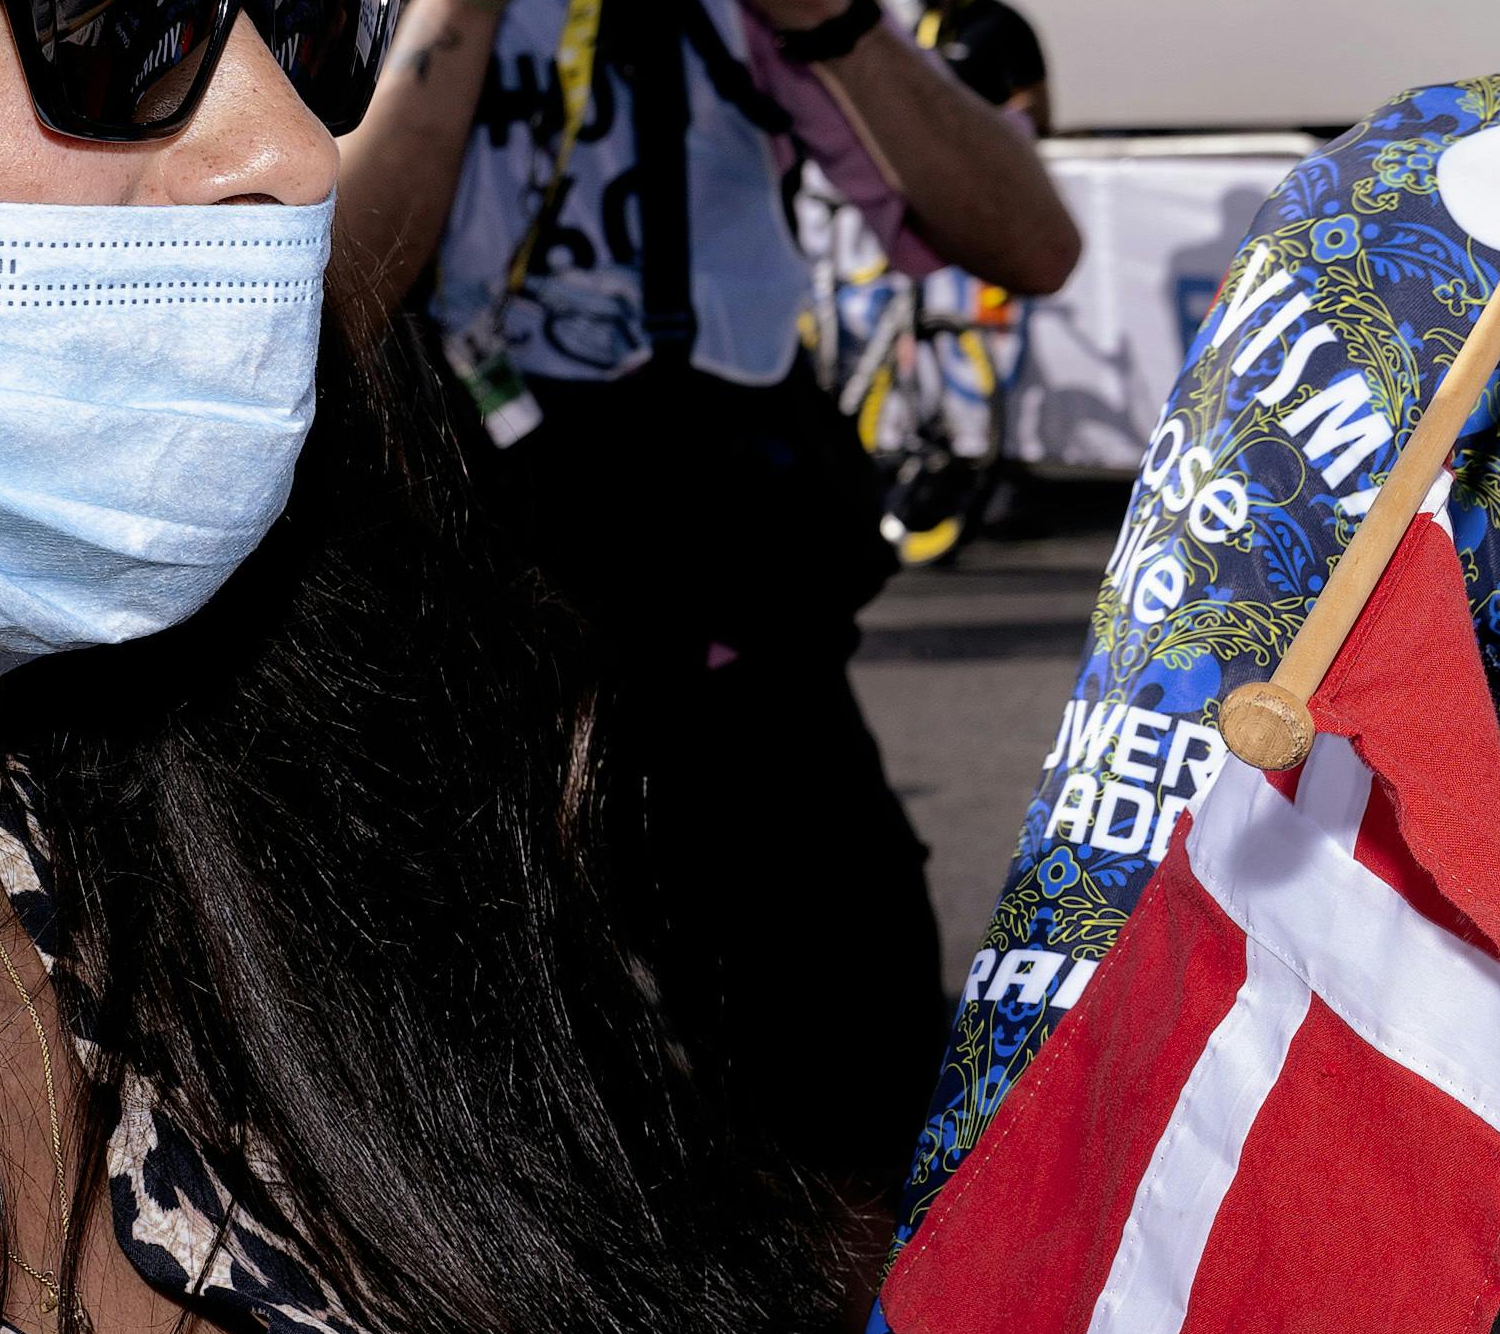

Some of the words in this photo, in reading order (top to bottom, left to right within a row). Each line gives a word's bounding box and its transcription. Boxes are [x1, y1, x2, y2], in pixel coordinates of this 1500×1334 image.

[1211, 243, 1394, 516] VISM
[1142, 402, 1249, 543] ase
[1105, 482, 1186, 624] ike
[1043, 699, 1228, 795] WER
